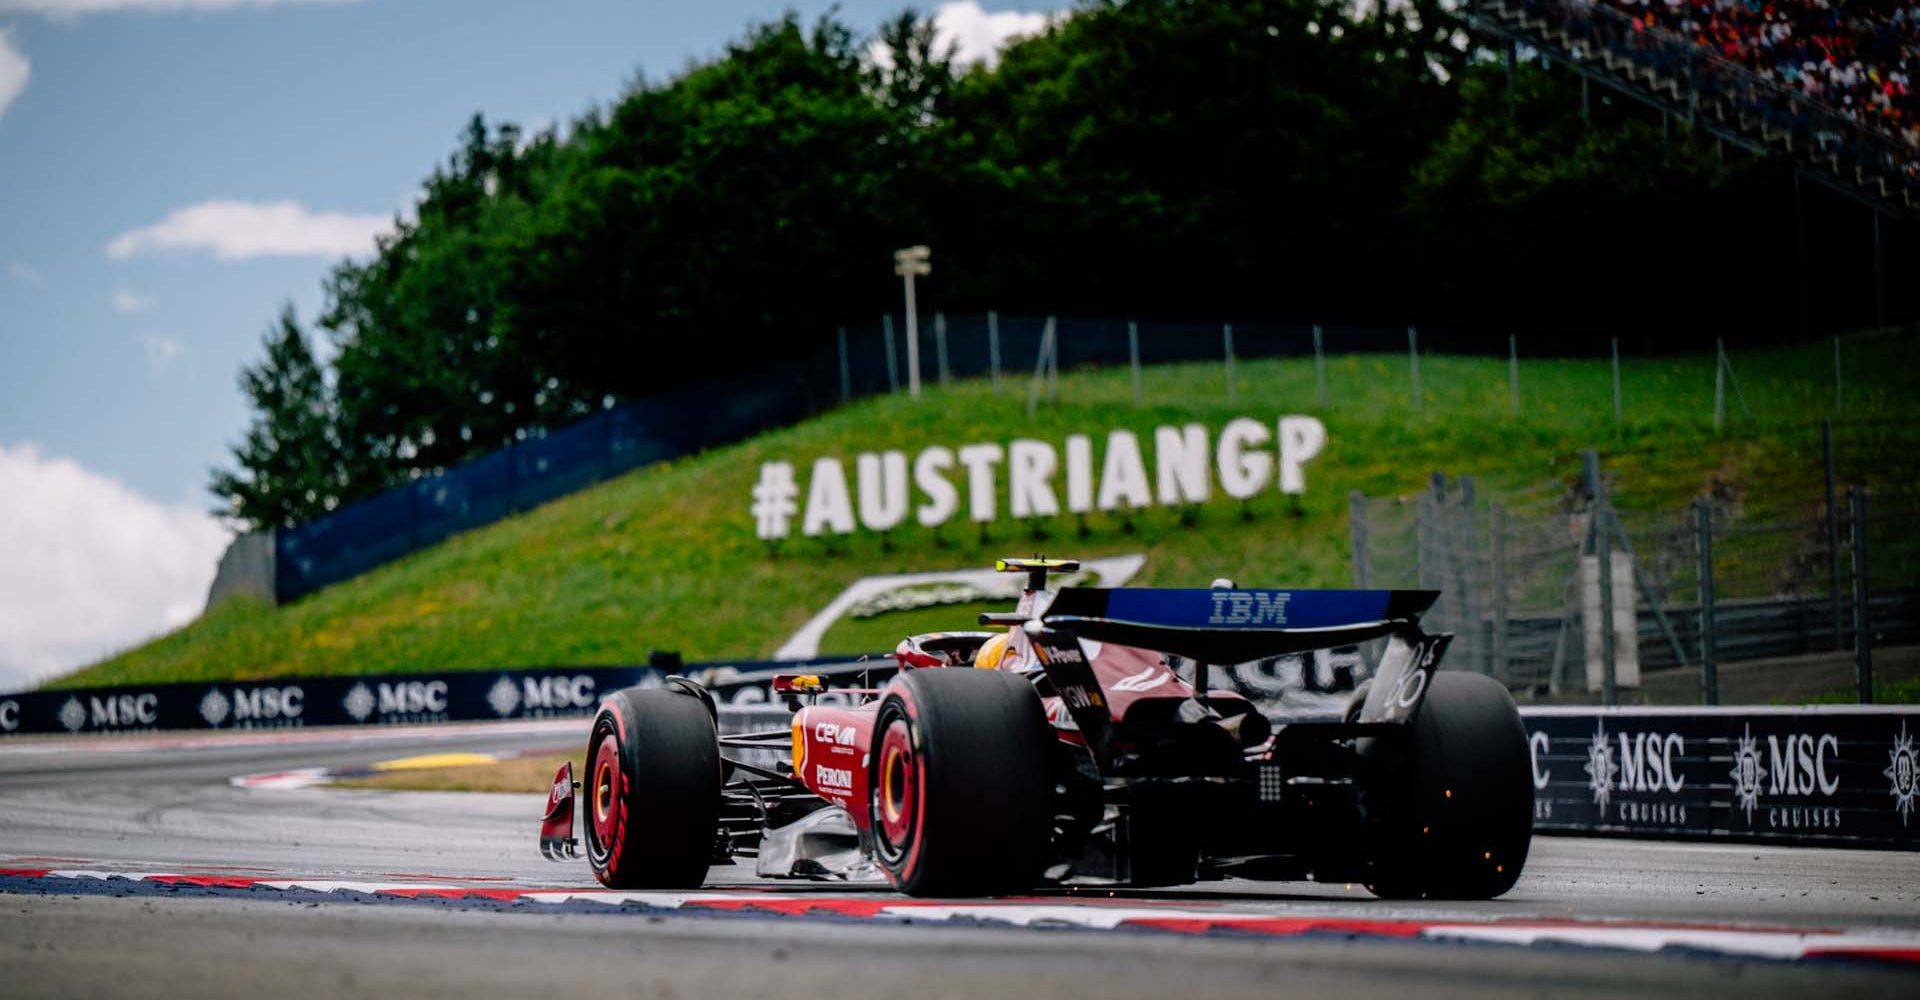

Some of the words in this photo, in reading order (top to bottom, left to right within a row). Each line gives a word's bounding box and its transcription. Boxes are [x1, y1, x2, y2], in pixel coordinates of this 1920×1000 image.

[751, 415, 1325, 539] #AUSTRIANGP
[1209, 592, 1291, 624] IBM
[234, 686, 304, 719] MSC
[378, 680, 448, 713] MSC
[523, 675, 595, 708] MSC
[90, 693, 158, 726] MSC
[816, 764, 852, 789] PERONI
[1618, 732, 1685, 793] MSC
[1768, 733, 1840, 796] MSC
[1619, 803, 1686, 825] CRUISES
[1769, 807, 1841, 828] CRUISES
